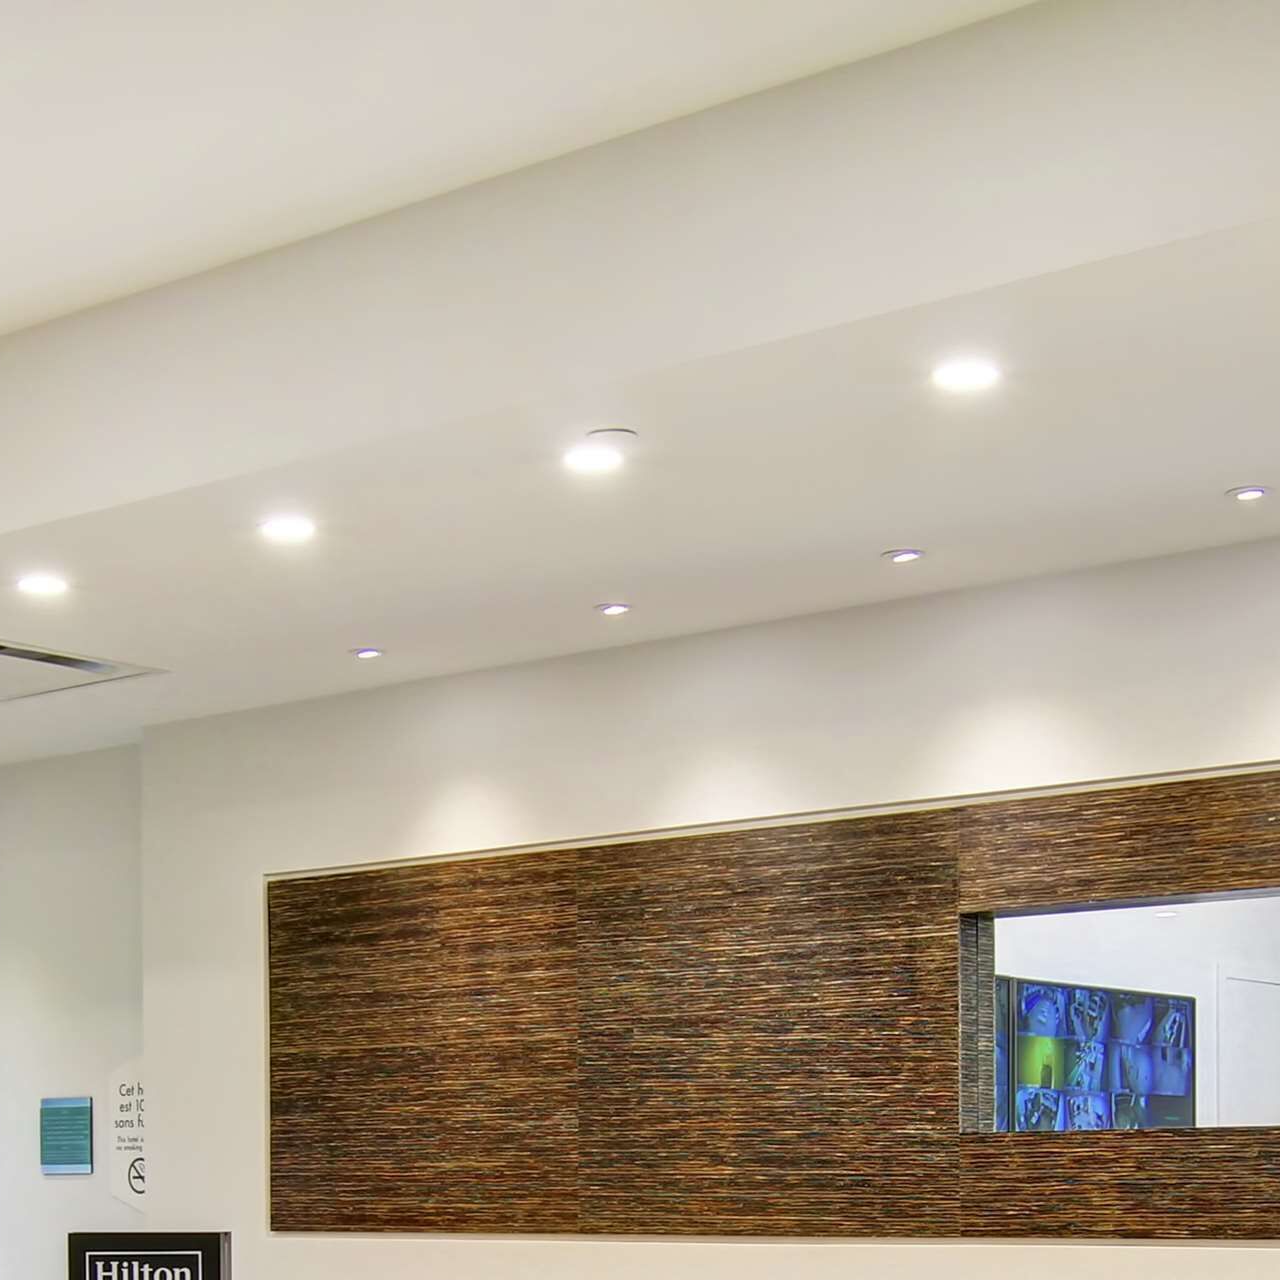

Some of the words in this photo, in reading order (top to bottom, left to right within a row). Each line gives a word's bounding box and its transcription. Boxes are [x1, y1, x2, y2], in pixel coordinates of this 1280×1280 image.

[119, 1083, 135, 1097] Cet
[119, 1102, 132, 1113] est
[114, 1118, 135, 1128] sans
